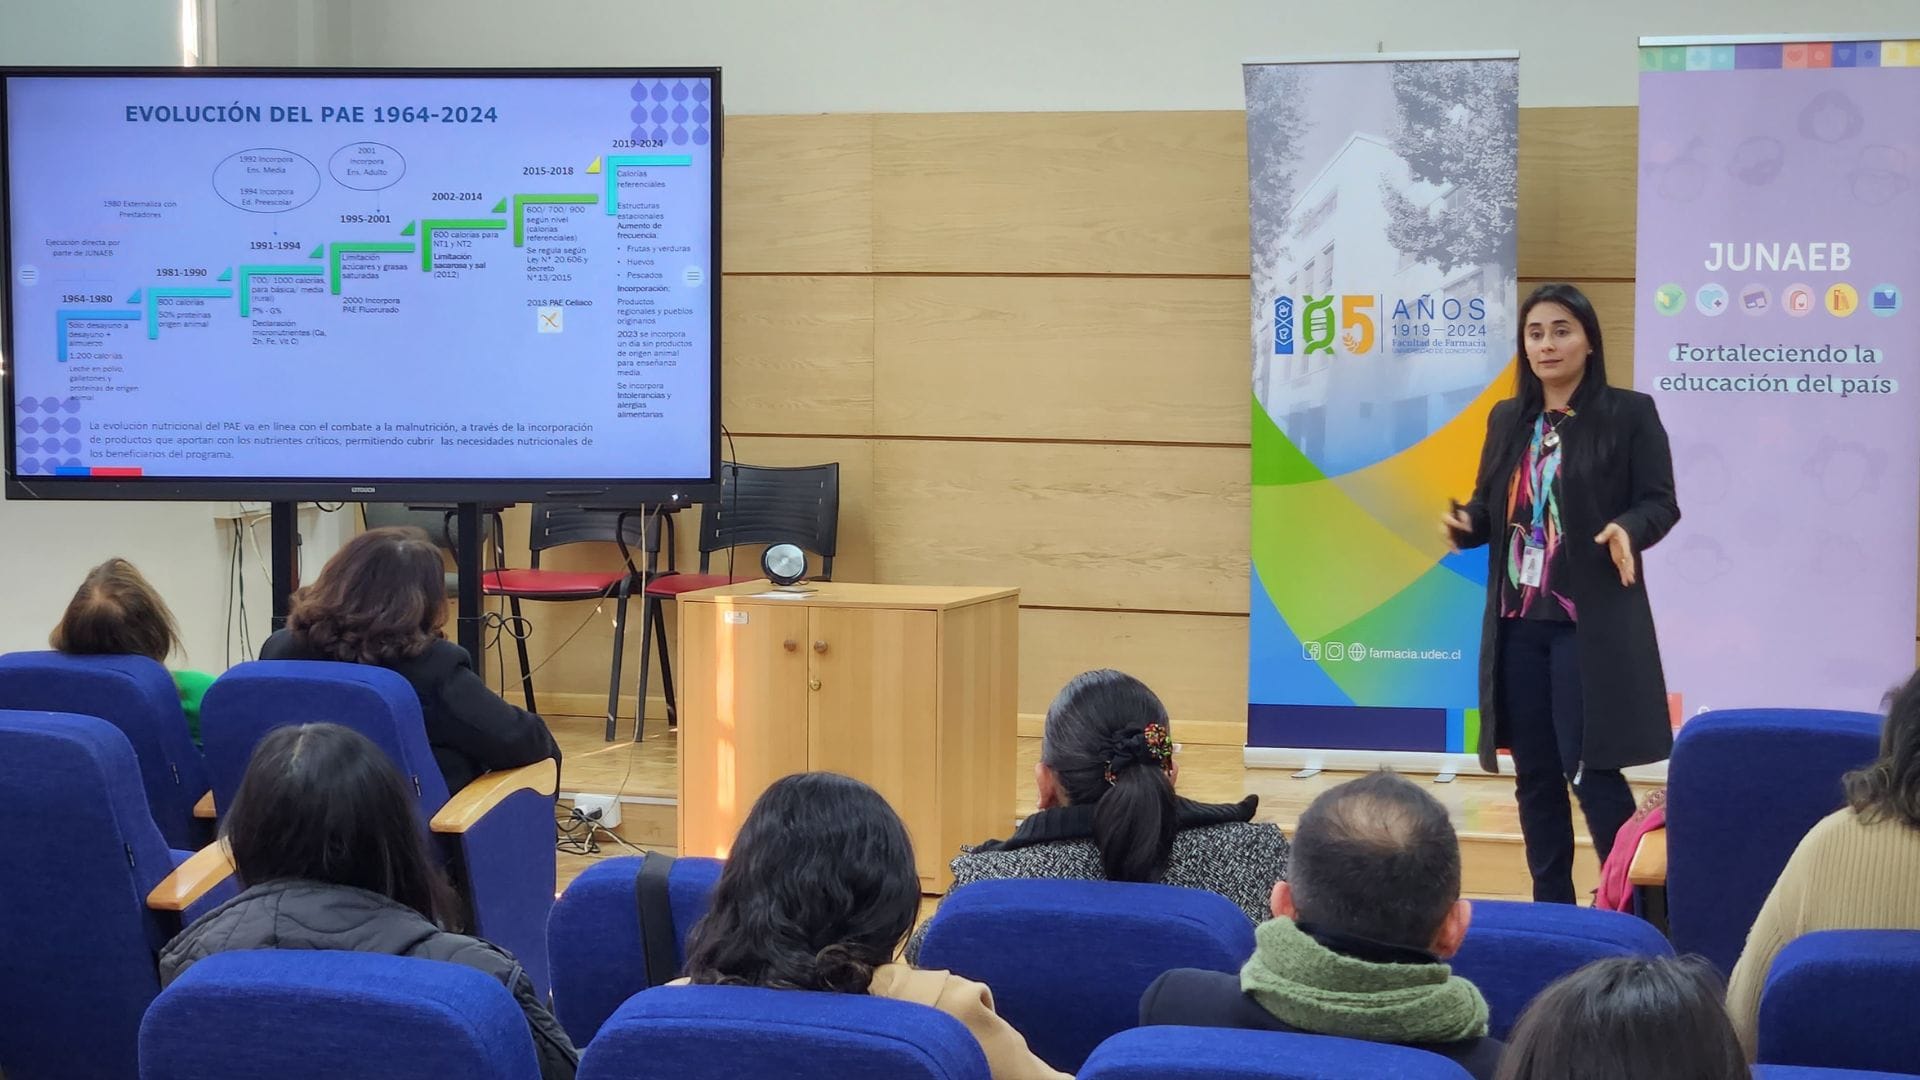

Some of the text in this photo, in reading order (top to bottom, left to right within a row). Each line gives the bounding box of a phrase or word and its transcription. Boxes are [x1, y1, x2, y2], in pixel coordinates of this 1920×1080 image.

[125, 101, 498, 122] EVOLUCIÓN DEL PAE 1964-2024
[612, 140, 664, 148] 2019-2024
[523, 167, 574, 175] 2015-2018
[432, 193, 483, 201] 2002-2014
[340, 215, 391, 223] 1995-2001
[250, 242, 301, 250] 1991-1994
[1704, 242, 1851, 272] JUNAEB
[156, 268, 207, 277] 1981-1990
[627, 271, 663, 279] Pescados
[62, 295, 113, 303] 1964-1980
[1392, 295, 1486, 320] AÑOS
[1392, 339, 1486, 348] Facultad de Farmacia
[1676, 343, 1876, 363] Fortaleciendo la
[628, 382, 664, 390] incorpora
[1659, 373, 1892, 397] educación del país
[89, 422, 100, 431] La
[152, 422, 202, 431] nutricional
[205, 422, 220, 431] del
[223, 422, 241, 431] PAE
[244, 422, 255, 431] va
[258, 422, 270, 431] en
[299, 422, 317, 431] con
[320, 422, 328, 431] el
[331, 422, 372, 431] combate
[384, 422, 393, 431] la
[502, 422, 514, 431] de
[517, 422, 525, 431] la
[528, 422, 593, 431] incorporación
[89, 436, 101, 445] de
[105, 436, 152, 445] productos
[155, 436, 173, 445] que
[176, 436, 214, 445] aportan
[217, 436, 234, 445] con
[237, 436, 251, 445] los
[254, 436, 303, 445] nutrientes
[345, 436, 404, 445] permitiendo
[406, 436, 434, 445] cubrir
[441, 436, 454, 445] las
[456, 436, 514, 445] necesidades
[517, 436, 578, 445] nutricionales
[581, 436, 593, 445] de
[89, 450, 103, 460] los
[105, 450, 166, 460] beneficiarios
[168, 450, 184, 460] del
[1369, 647, 1462, 661] farmacia.udec.cl
